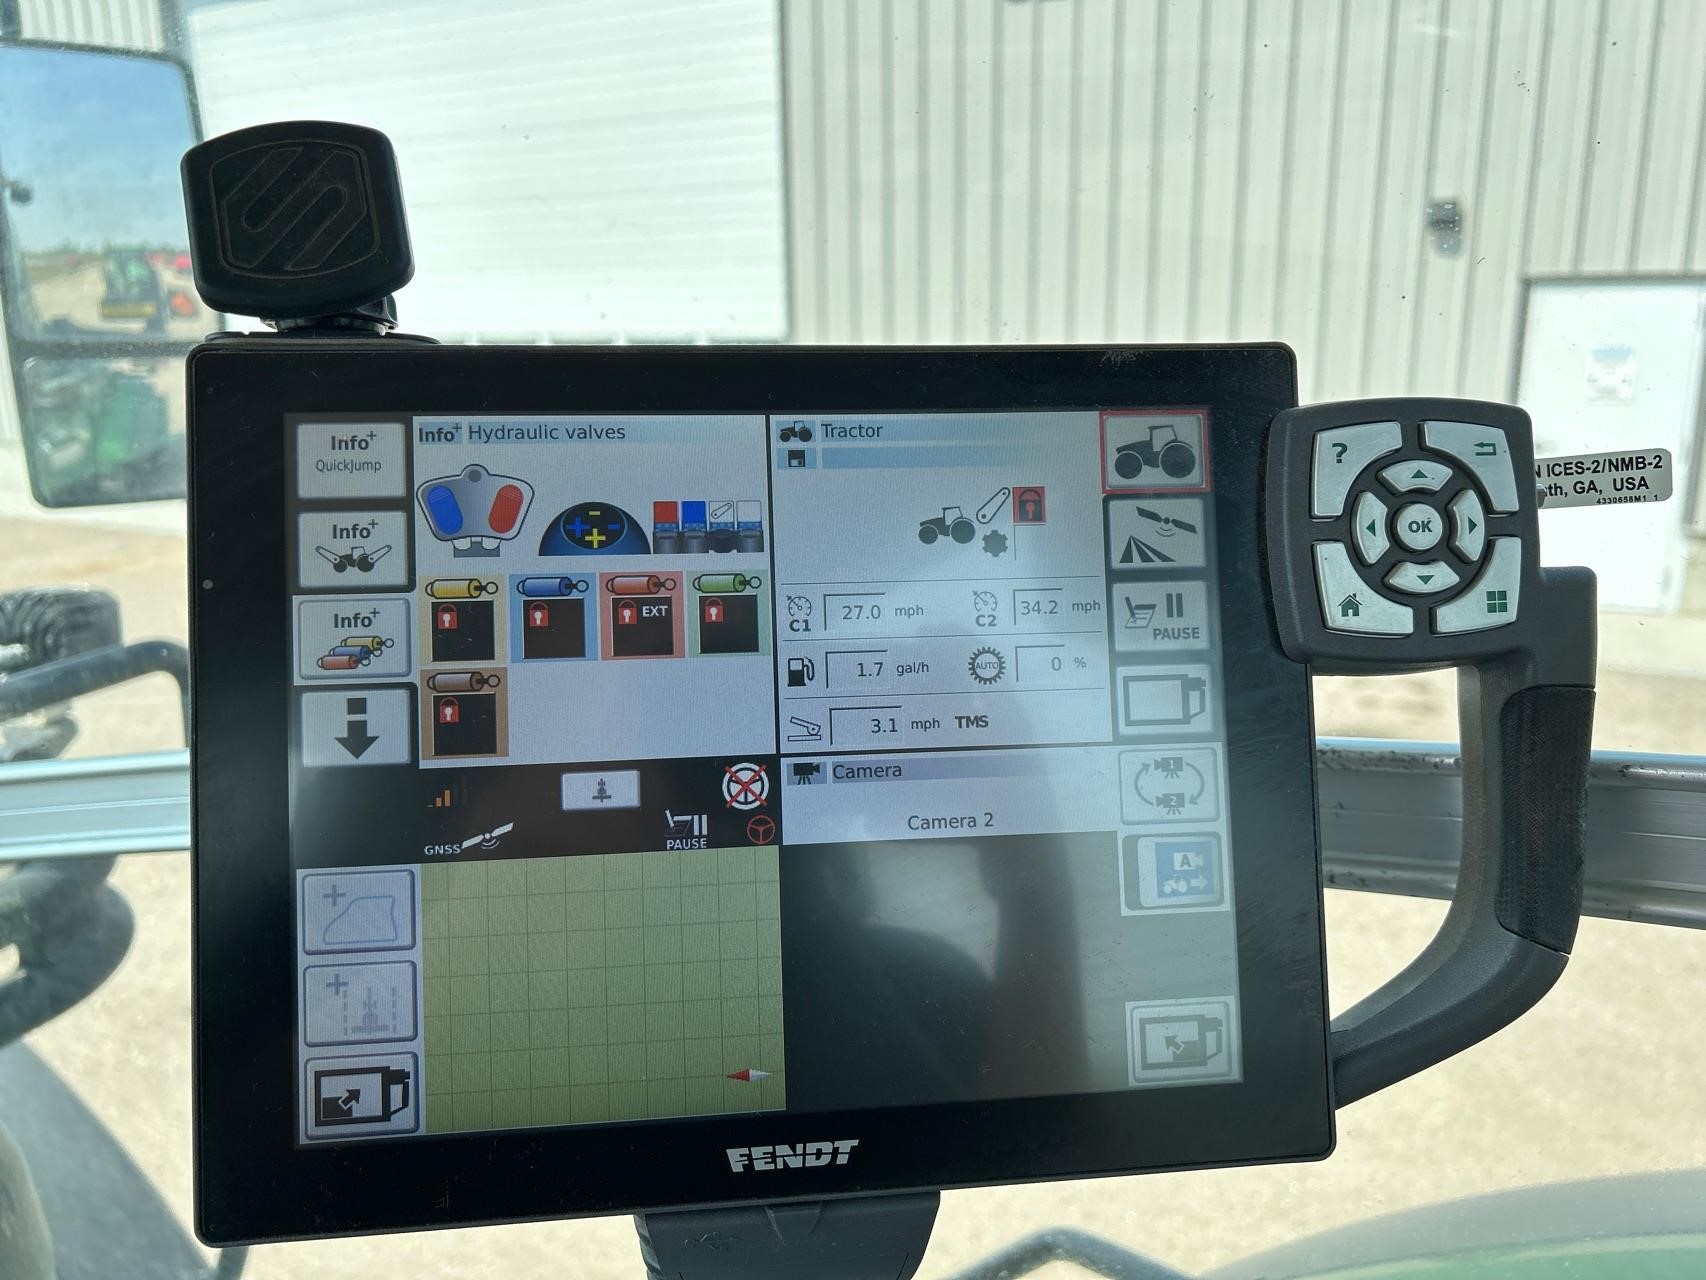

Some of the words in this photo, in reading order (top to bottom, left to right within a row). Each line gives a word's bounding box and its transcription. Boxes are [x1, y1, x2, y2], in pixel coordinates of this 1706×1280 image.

[468, 424, 559, 443] Hydraulic
[565, 424, 626, 439] valves
[820, 422, 884, 439] Tractor
[315, 458, 382, 473] QuickJump
[1546, 454, 1663, 478] ICES-2/NMB-2
[1573, 480, 1603, 496] GA,
[1612, 476, 1650, 492] USA
[1407, 519, 1433, 534] OK
[642, 605, 668, 617] EXT
[842, 605, 882, 621] 27.0
[894, 605, 925, 619] mph
[1020, 600, 1059, 616] 34.2
[1072, 600, 1102, 613] mph
[789, 620, 812, 633] C1
[975, 614, 997, 628] C2
[1153, 627, 1200, 641] PAUSE
[857, 661, 884, 678] 1.7
[896, 661, 930, 677] gal/h
[976, 660, 1000, 670] AUTO
[1051, 657, 1062, 671] 0
[871, 718, 898, 734] 3.1
[911, 718, 941, 731] mph
[955, 715, 989, 729] TMS
[832, 763, 903, 780] Camera
[907, 814, 977, 831] Camera
[984, 812, 994, 828] 2
[424, 844, 461, 856] GNSS
[666, 838, 708, 851] PAUSE
[1180, 854, 1191, 868] A
[726, 1139, 860, 1173] FENDT
